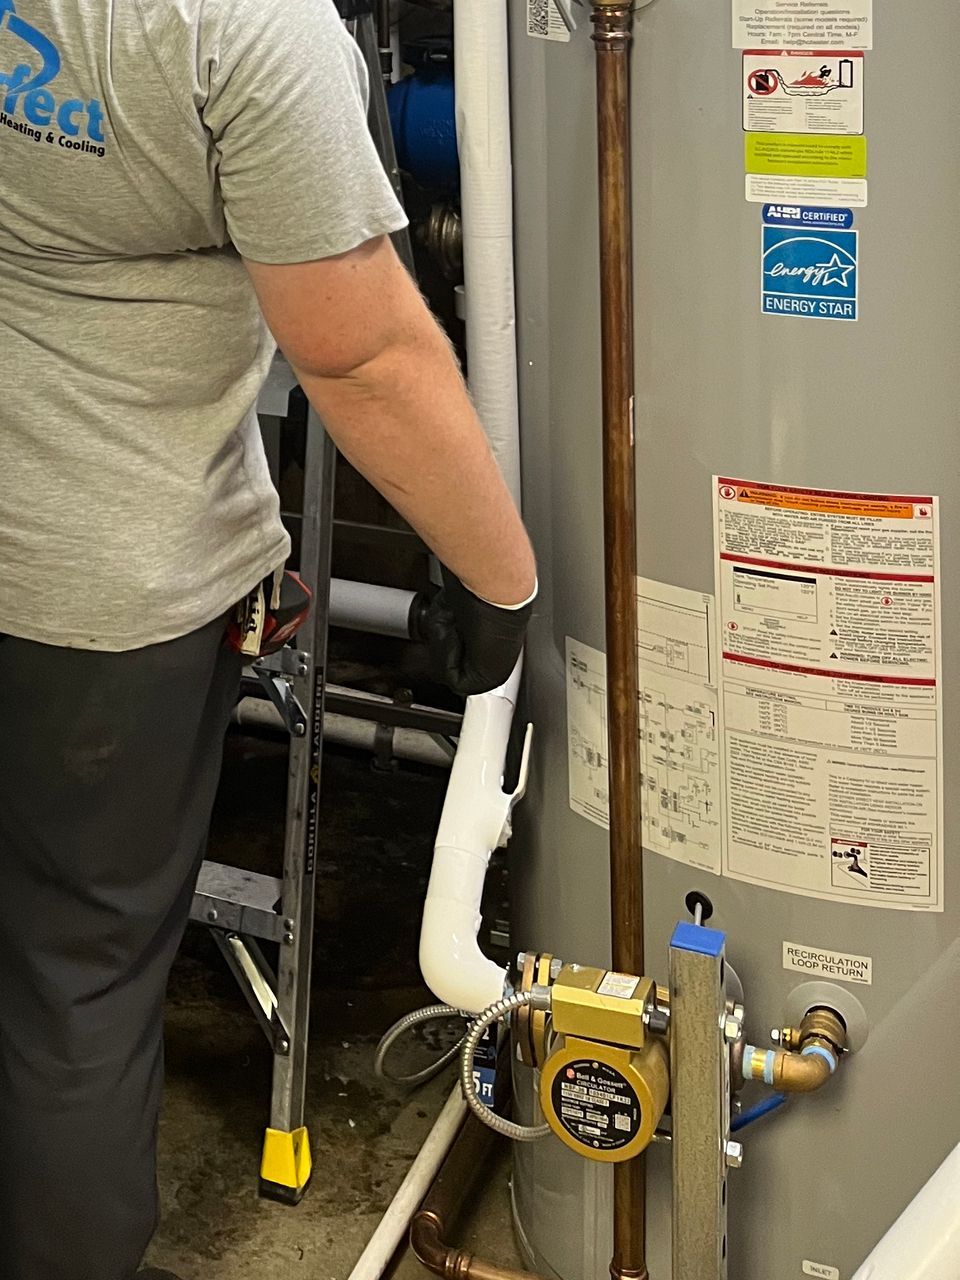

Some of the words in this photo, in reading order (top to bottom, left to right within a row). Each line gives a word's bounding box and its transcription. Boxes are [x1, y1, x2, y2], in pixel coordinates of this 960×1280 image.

[0, 112, 42, 142] Heating
[45, 132, 54, 144] &
[58, 135, 106, 158] Cooling
[802, 212, 845, 222] CERTIFIED
[770, 262, 828, 286] energy
[766, 298, 816, 313] ENERGY
[818, 301, 852, 315] STAR
[306, 791, 317, 872] GORILLA
[313, 673, 323, 757] LADDERS
[787, 947, 868, 970] RECIRCULATION
[792, 958, 819, 969] LOOP
[822, 963, 863, 977] RETURN
[482, 1083, 493, 1097] FT
[576, 1080, 616, 1093] CIRCULATOR
